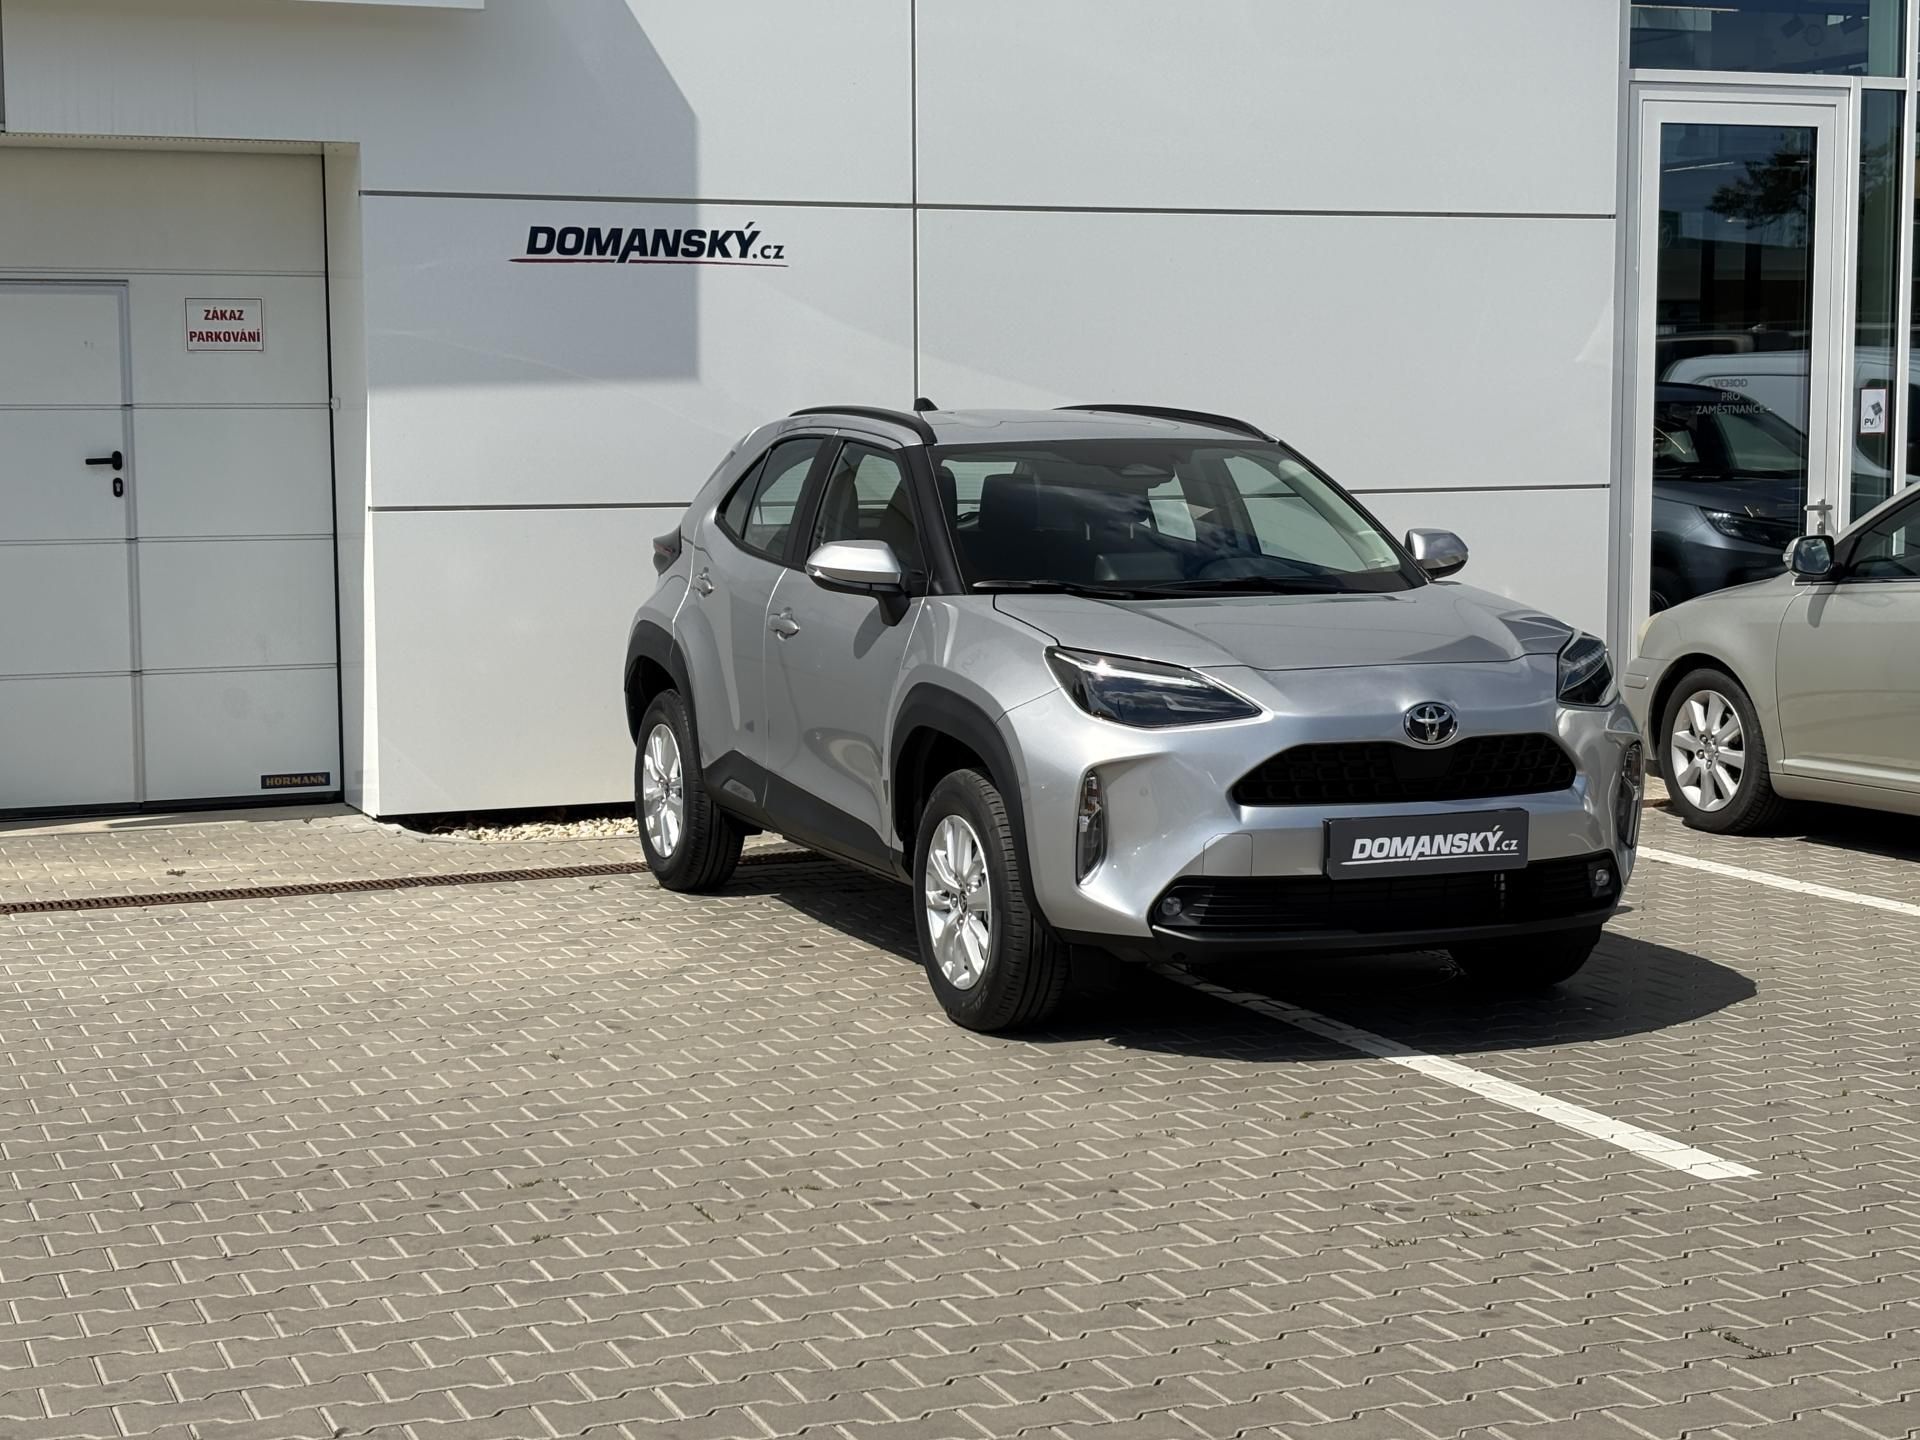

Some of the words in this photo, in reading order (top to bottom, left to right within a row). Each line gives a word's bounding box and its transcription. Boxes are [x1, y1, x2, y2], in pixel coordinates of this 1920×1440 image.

[204, 307, 244, 321] ZÁKAZ
[189, 328, 261, 343] PARKOVÁNÍ
[1721, 391, 1741, 401] PRO
